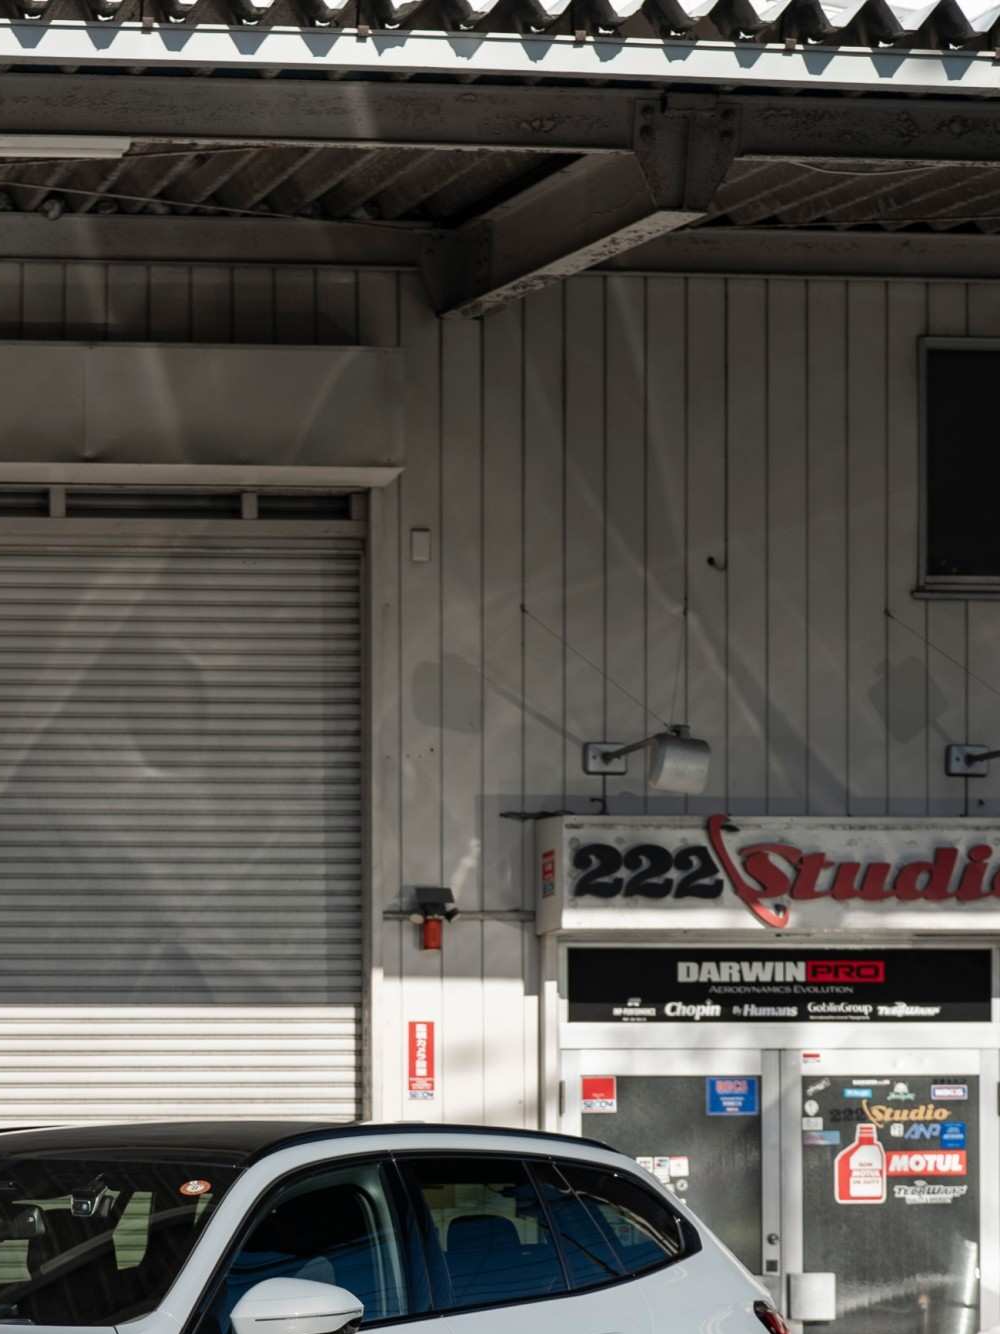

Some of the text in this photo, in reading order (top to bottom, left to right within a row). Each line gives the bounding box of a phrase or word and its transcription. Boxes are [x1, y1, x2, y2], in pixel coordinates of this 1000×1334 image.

[573, 843, 724, 898] 222
[677, 961, 883, 983] DARWIN PRO
[664, 998, 722, 1021] Chopin
[743, 1003, 798, 1018] Humans
[807, 1001, 873, 1016] GoblinGroup
[865, 1101, 951, 1125] Studio
[888, 1154, 963, 1172] MOTUL
